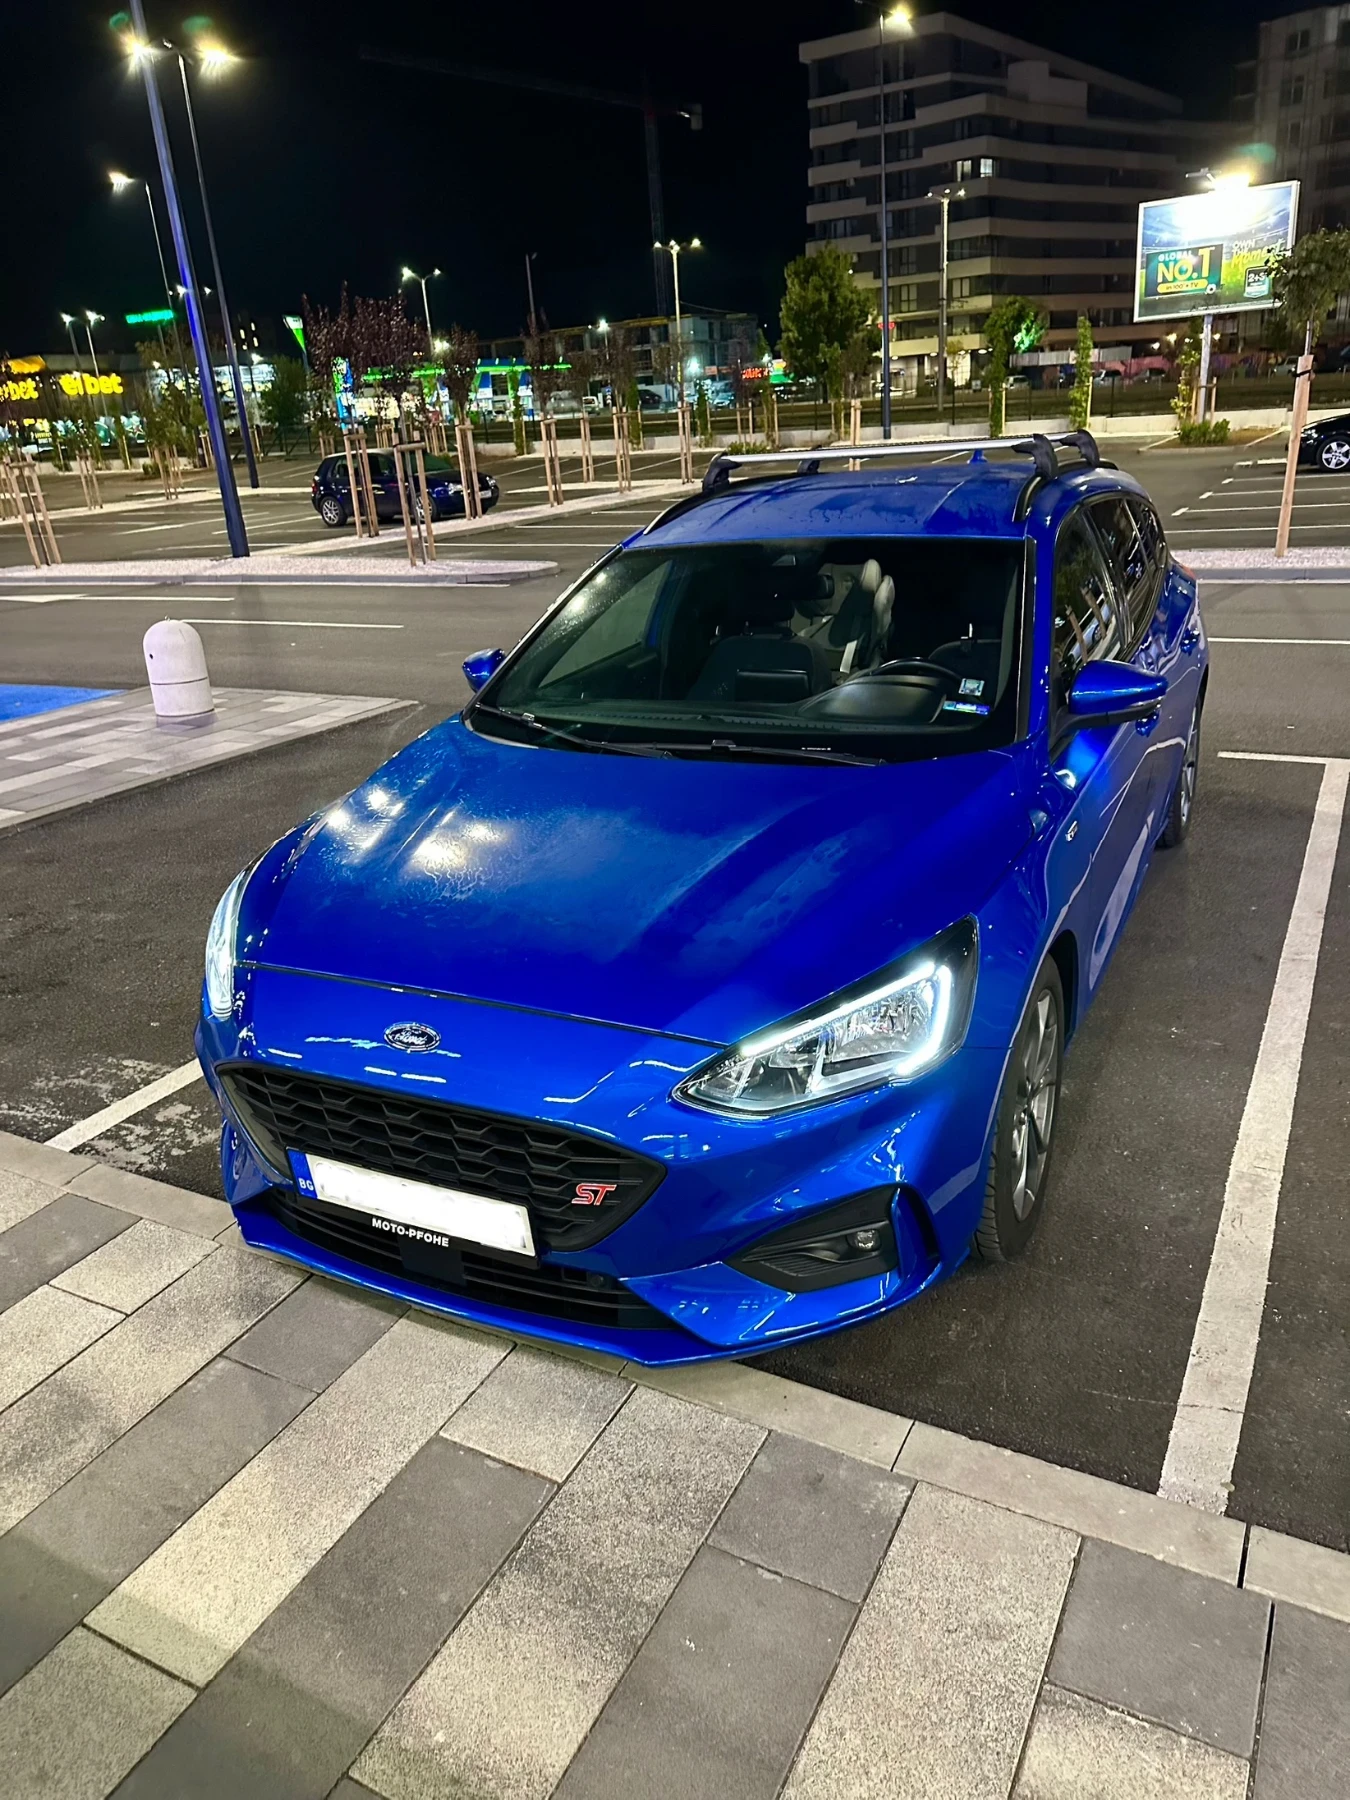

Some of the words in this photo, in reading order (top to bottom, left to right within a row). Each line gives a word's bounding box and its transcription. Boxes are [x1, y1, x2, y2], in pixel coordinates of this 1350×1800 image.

[1158, 250, 1193, 262] GLOBAL
[1157, 247, 1214, 283] NO.1
[391, 1029, 428, 1046] Ford
[298, 1178, 314, 1191] BG
[571, 1183, 617, 1206] ST
